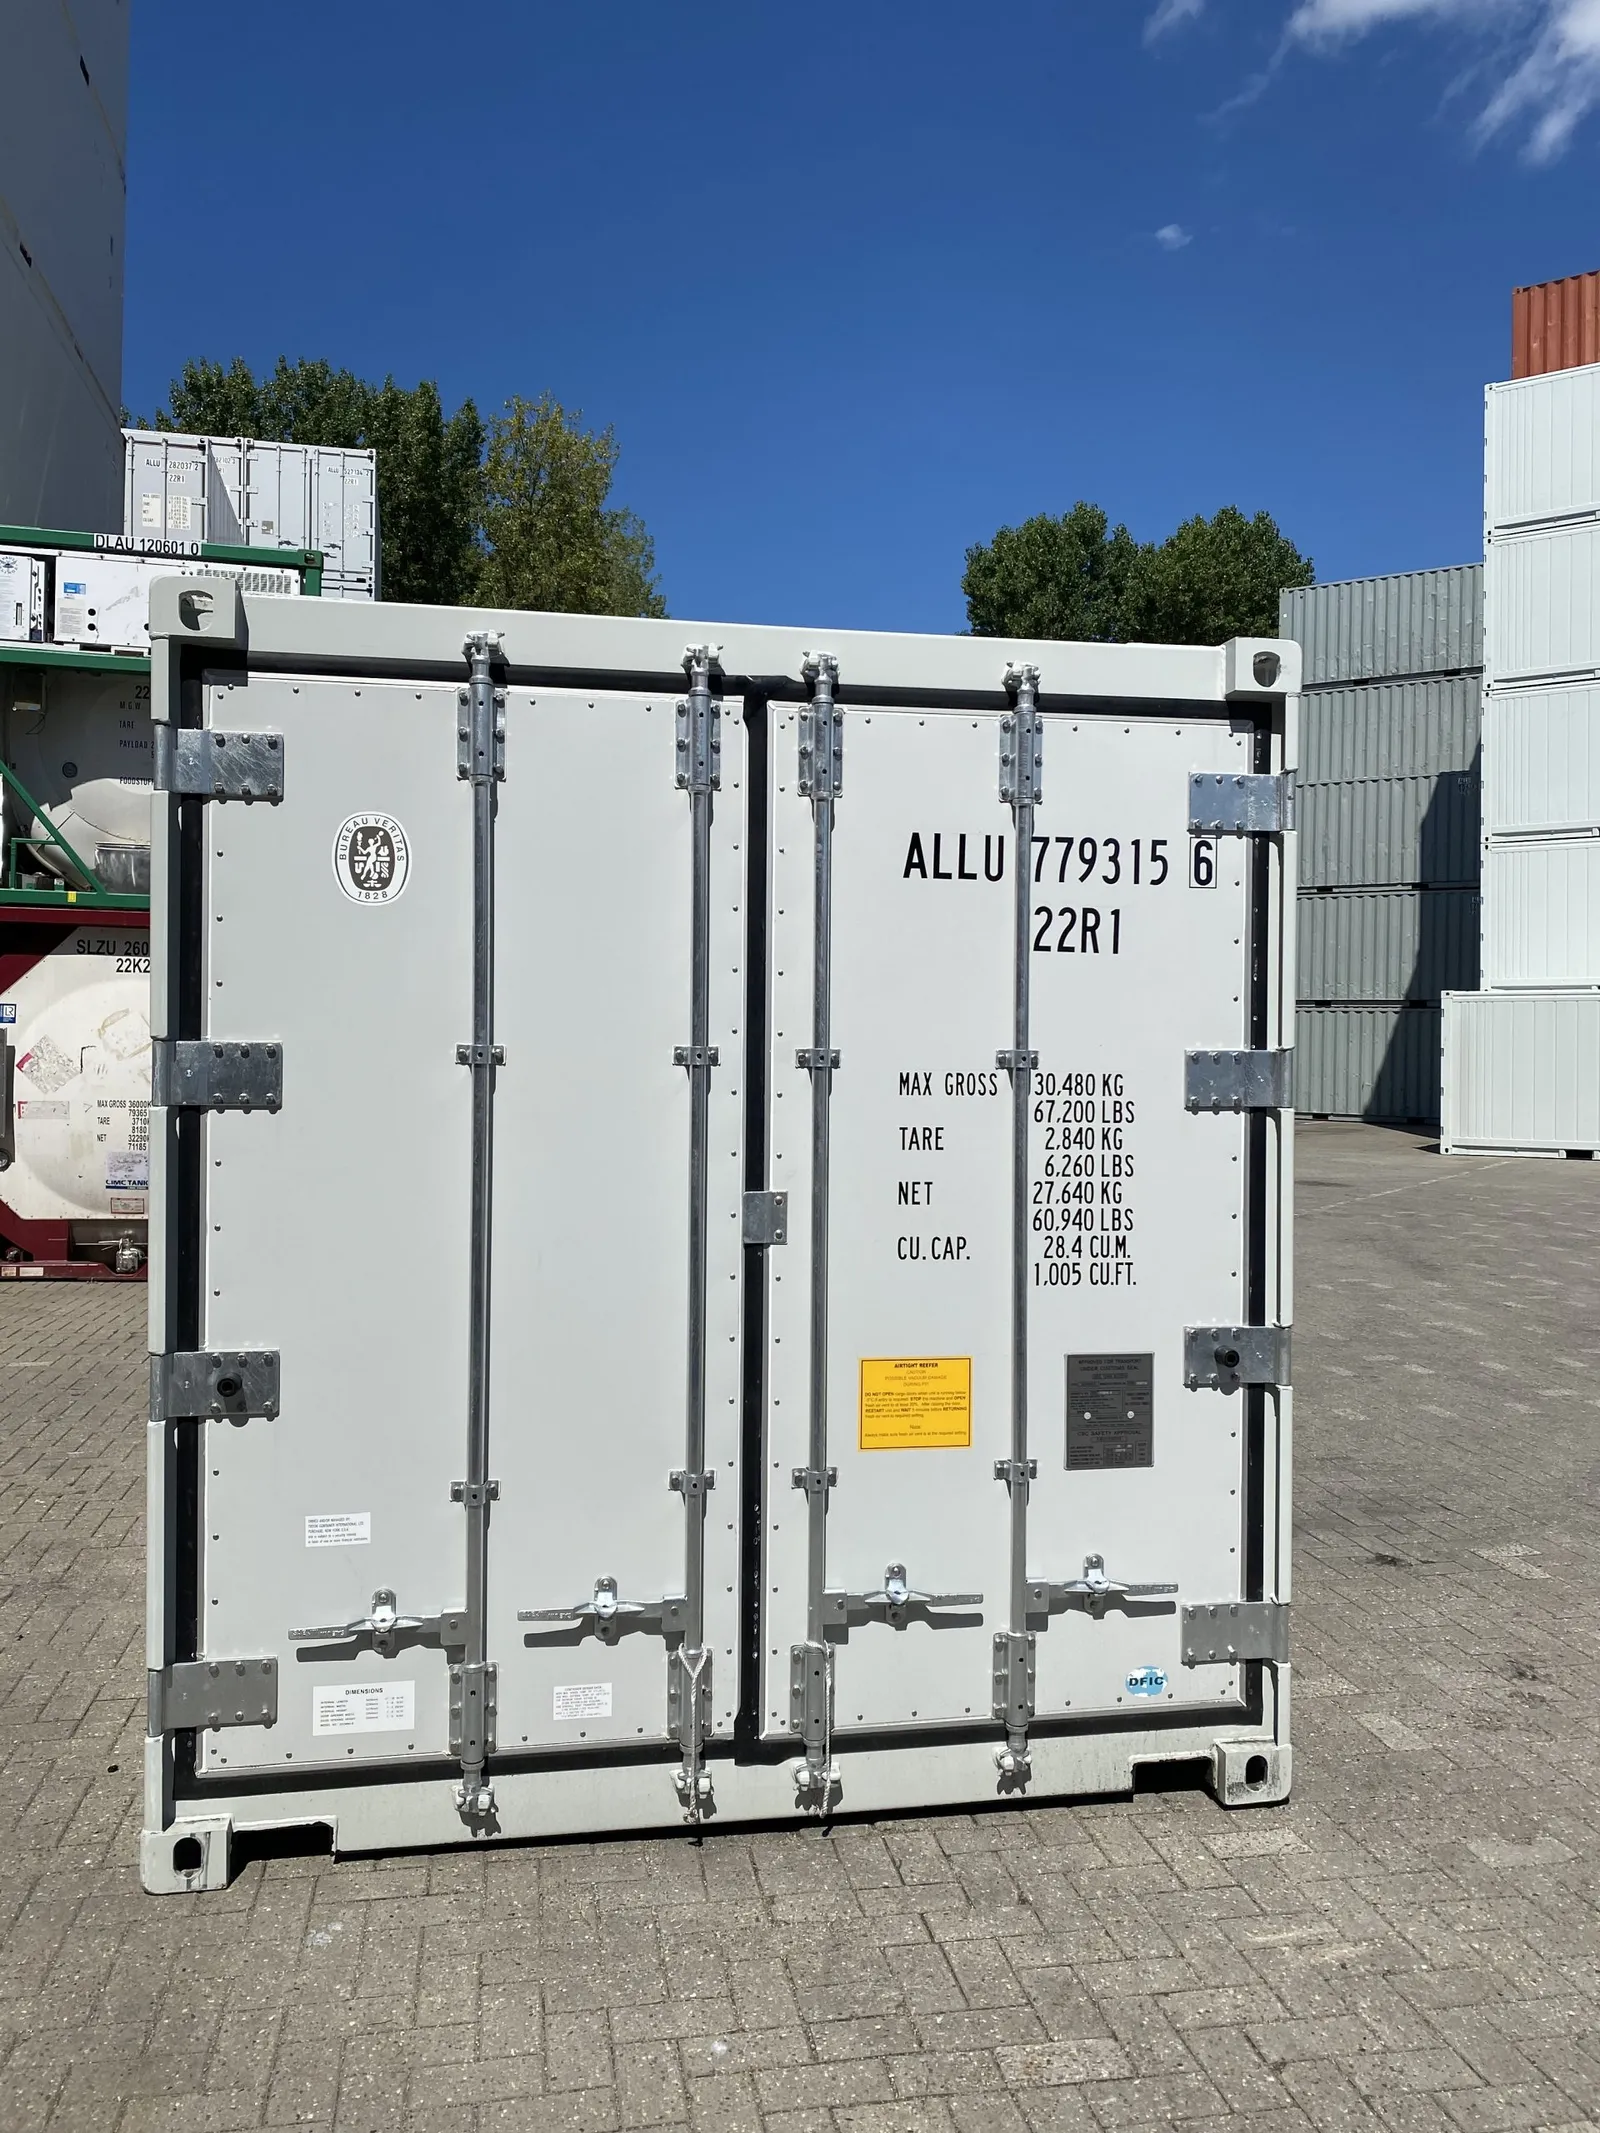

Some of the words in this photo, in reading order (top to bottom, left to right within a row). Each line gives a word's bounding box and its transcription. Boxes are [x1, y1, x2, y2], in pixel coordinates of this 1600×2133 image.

[146, 459, 161, 467] ALLU
[169, 461, 192, 470] 282037
[169, 475, 185, 483] 22R1
[95, 534, 135, 551] DLAU
[139, 538, 185, 555] 120601
[190, 542, 199, 556] 0
[119, 720, 134, 729] TARE
[119, 740, 148, 749] PAYLOAD
[339, 817, 369, 861] BUREAU
[374, 817, 405, 862] VERITAS
[903, 832, 1004, 882] ALLU
[1031, 836, 1169, 886] 779315
[1193, 840, 1214, 886] 6
[358, 891, 388, 900] 1828
[1033, 906, 1121, 955] 22R1
[76, 939, 116, 955] SLZU
[124, 941, 149, 956] 260
[116, 958, 150, 973] 22K2
[899, 1072, 933, 1096] MAX
[945, 1072, 998, 1097] GROSS
[1034, 1073, 1096, 1097] 30,480
[1102, 1073, 1124, 1097] KG
[97, 1100, 108, 1108] MAX
[109, 1100, 127, 1108] GROSS
[128, 1109, 148, 1117] 79365
[1034, 1100, 1095, 1124] 67,200
[1101, 1100, 1135, 1124] LBS
[97, 1117, 110, 1125] TARE
[131, 1126, 147, 1134] 8180
[97, 1134, 107, 1142] NET
[899, 1127, 944, 1151] TARE
[1045, 1127, 1095, 1151] 2,840
[1101, 1127, 1123, 1150] KG
[128, 1143, 147, 1151] 71185
[1044, 1154, 1094, 1178] 6,260
[1101, 1154, 1134, 1178] LBS
[898, 1181, 933, 1205] NET
[1032, 1181, 1094, 1205] 27,640
[1100, 1181, 1122, 1205] KG
[1032, 1208, 1094, 1232] 60,940
[1100, 1208, 1134, 1232] LBS
[897, 1236, 971, 1260] CU.CAP.
[1043, 1235, 1083, 1259] 28.4
[1090, 1236, 1131, 1259] CU.M.
[1034, 1262, 1081, 1286] 1,005
[1089, 1262, 1137, 1286] CU.FT.
[1129, 1676, 1164, 1687] DFIC
[345, 1687, 384, 1696] DIMENSIONS
